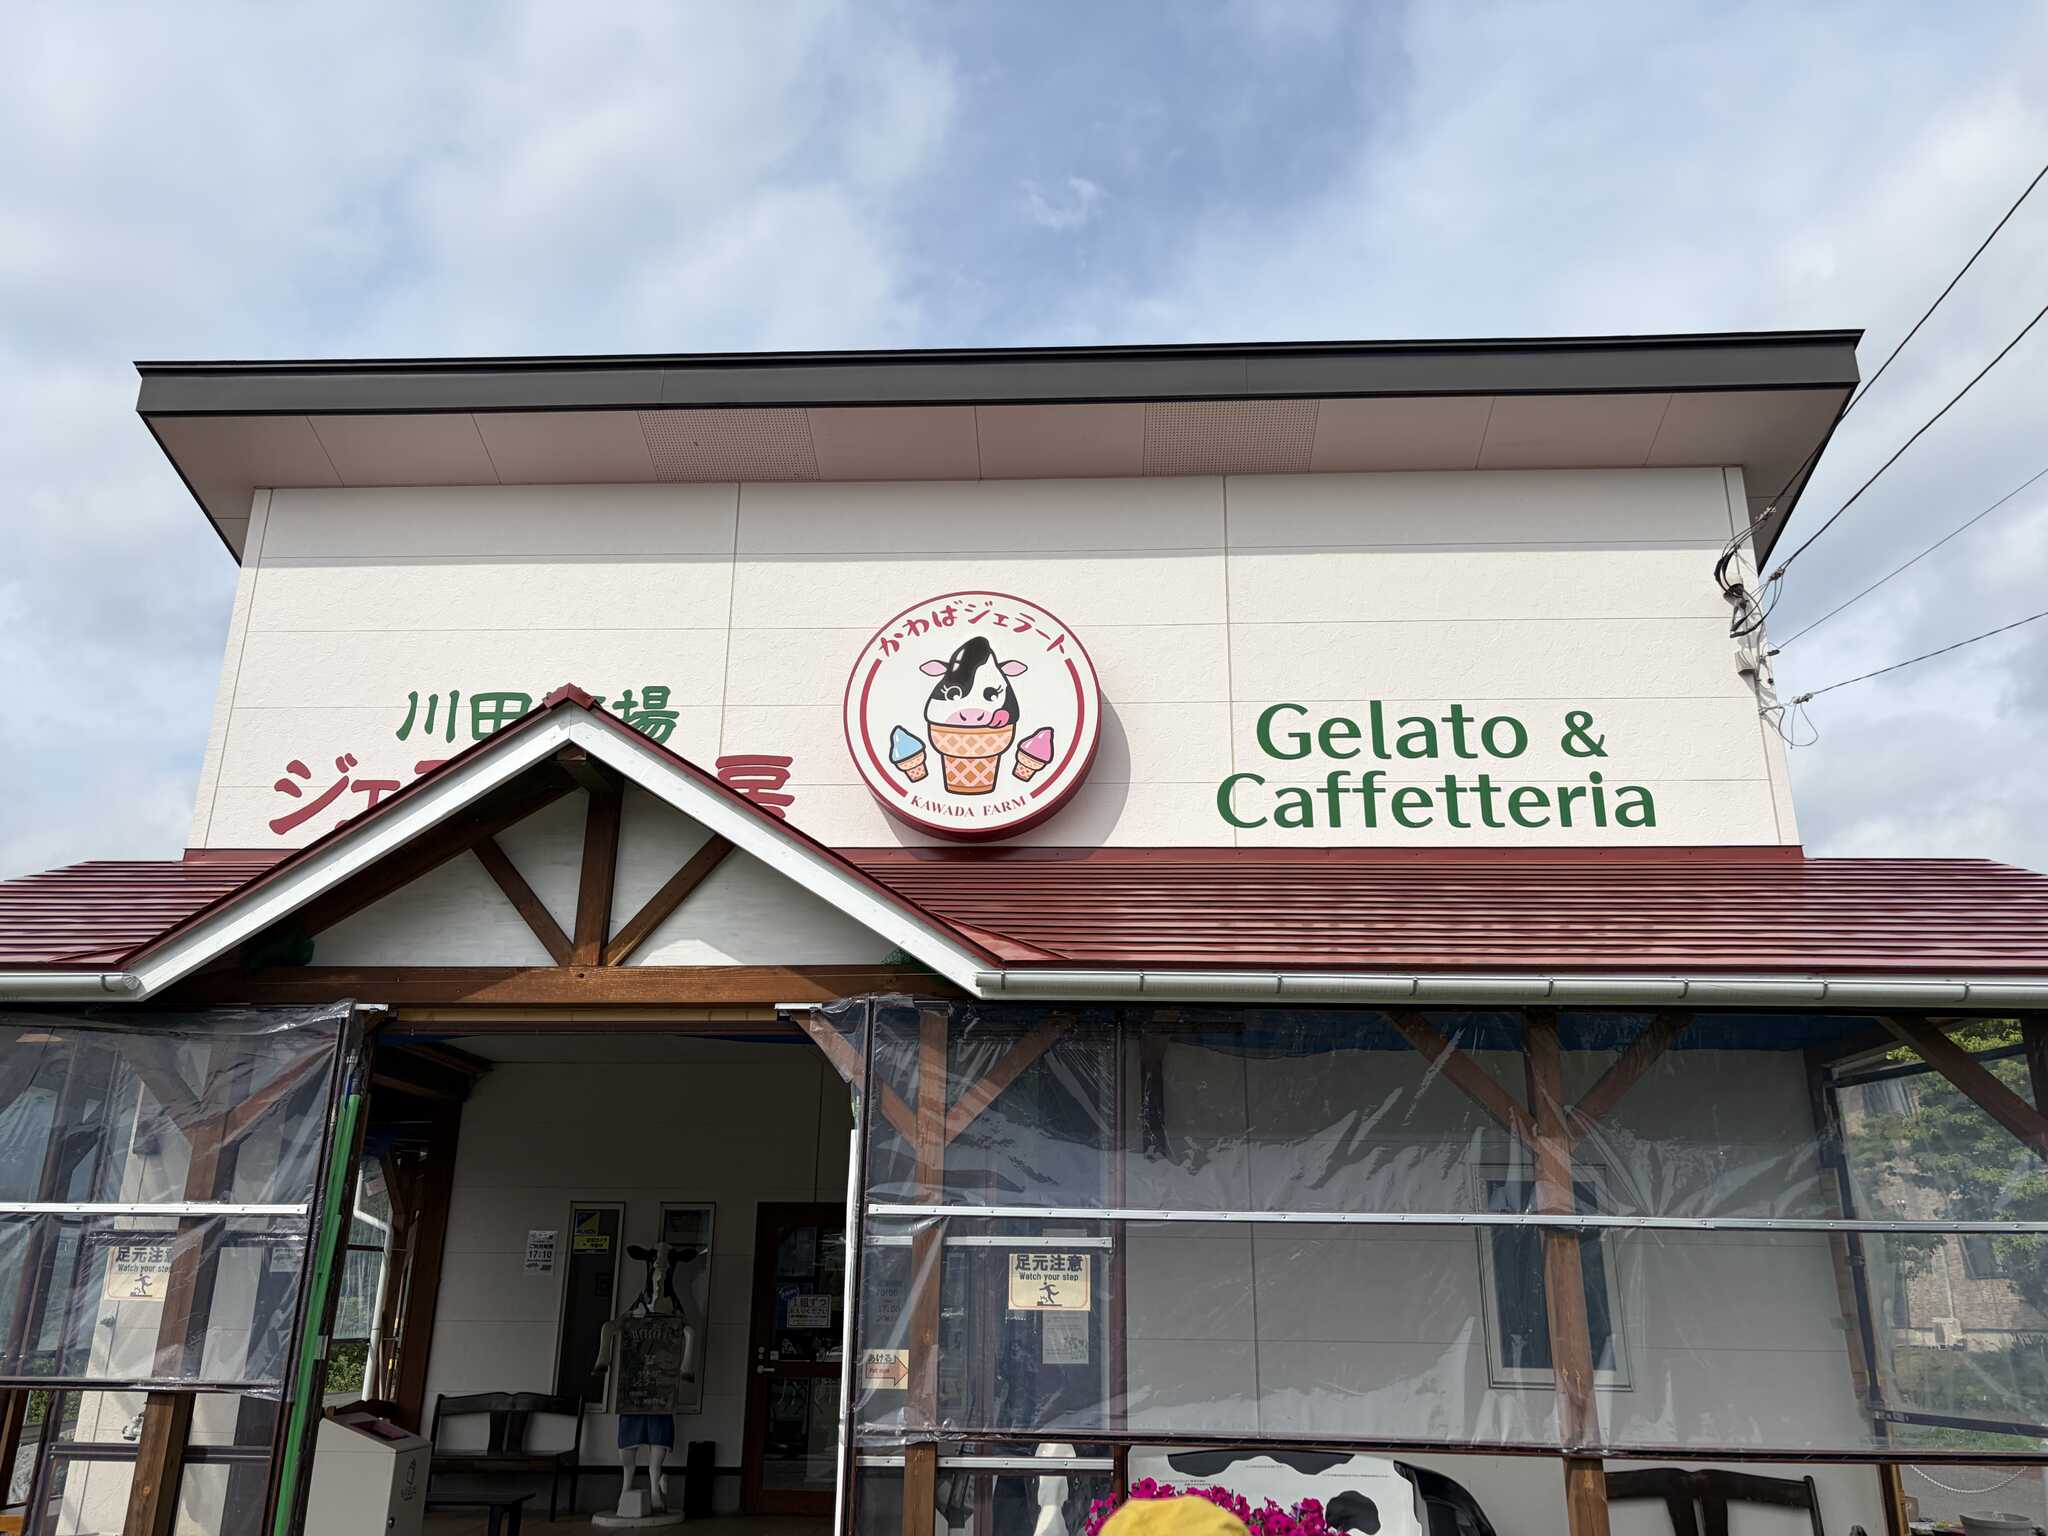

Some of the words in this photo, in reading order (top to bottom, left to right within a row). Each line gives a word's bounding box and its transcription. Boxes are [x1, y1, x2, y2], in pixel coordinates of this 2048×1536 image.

[879, 601, 1065, 656] かわばジェラート
[396, 685, 681, 744] 川田場
[1256, 700, 1530, 760] Gelato
[1559, 710, 1609, 757] &
[910, 794, 975, 818] KAWADA
[983, 796, 1027, 817] FARM
[1216, 770, 1657, 829] Caffetteria
[1015, 1254, 1083, 1271] 足元注意
[1019, 1272, 1041, 1280] Watch
[1044, 1273, 1060, 1281] your
